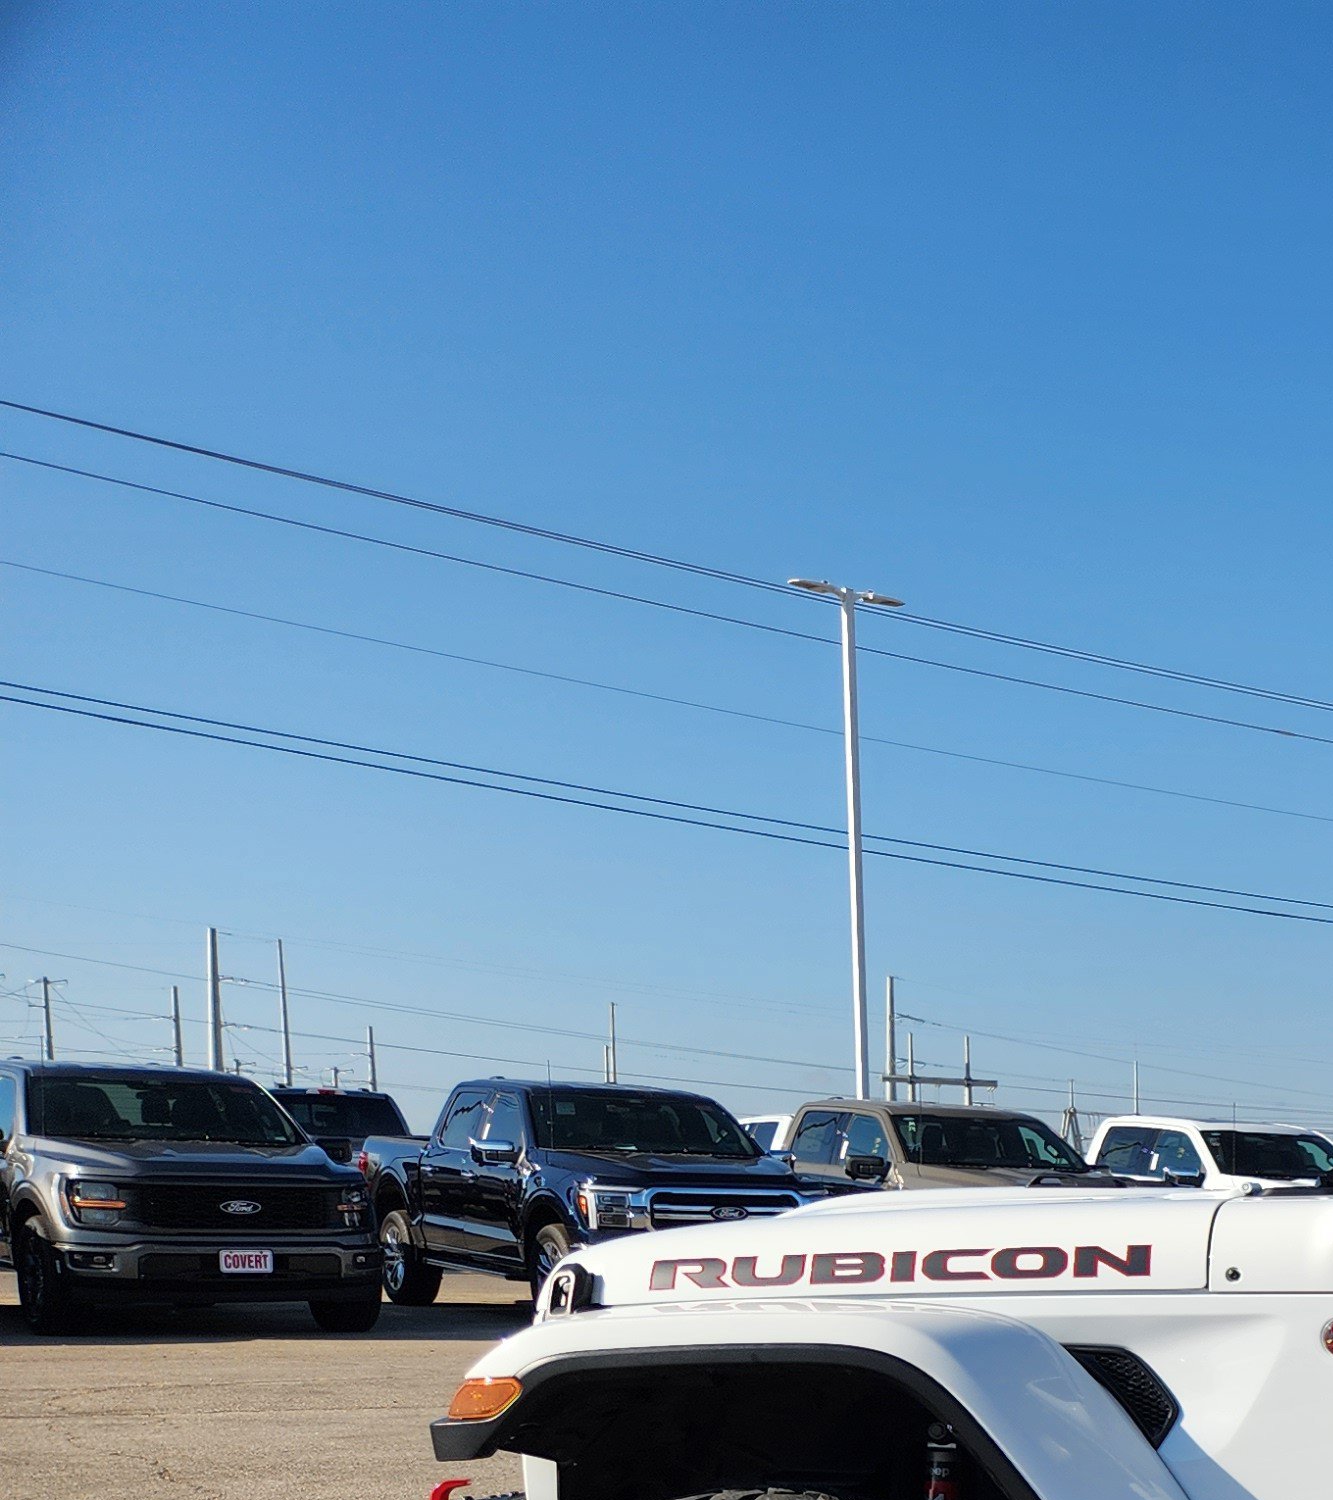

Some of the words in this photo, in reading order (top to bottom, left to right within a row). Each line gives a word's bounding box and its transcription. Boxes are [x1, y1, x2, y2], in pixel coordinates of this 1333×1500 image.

[227, 1201, 254, 1212] Ford
[224, 1253, 269, 1269] COVERT
[648, 1244, 1153, 1291] RUBICON
